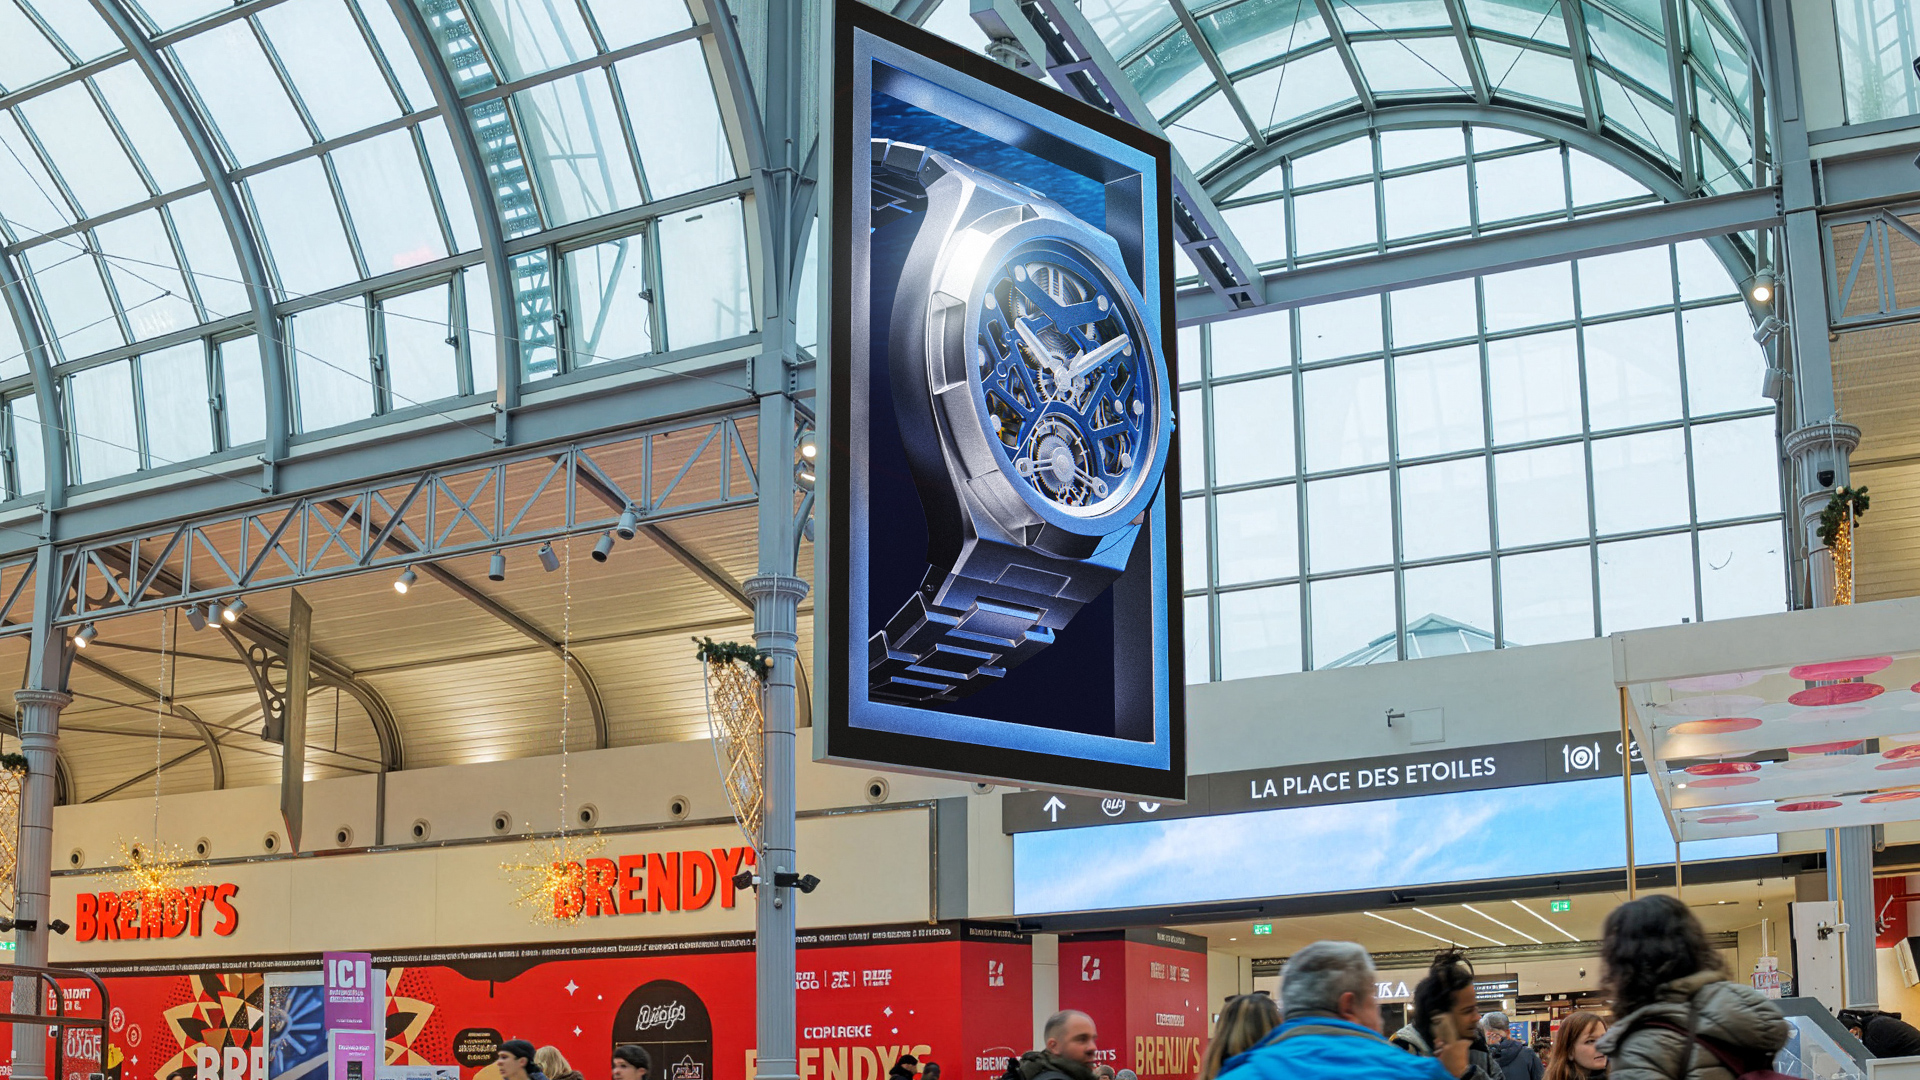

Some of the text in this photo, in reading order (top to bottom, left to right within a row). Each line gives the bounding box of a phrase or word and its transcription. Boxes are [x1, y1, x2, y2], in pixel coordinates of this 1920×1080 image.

[1250, 757, 1497, 799] LA PLACE DES ETOILES
[552, 846, 756, 918] BRENDY'
[328, 959, 367, 988] ICI
